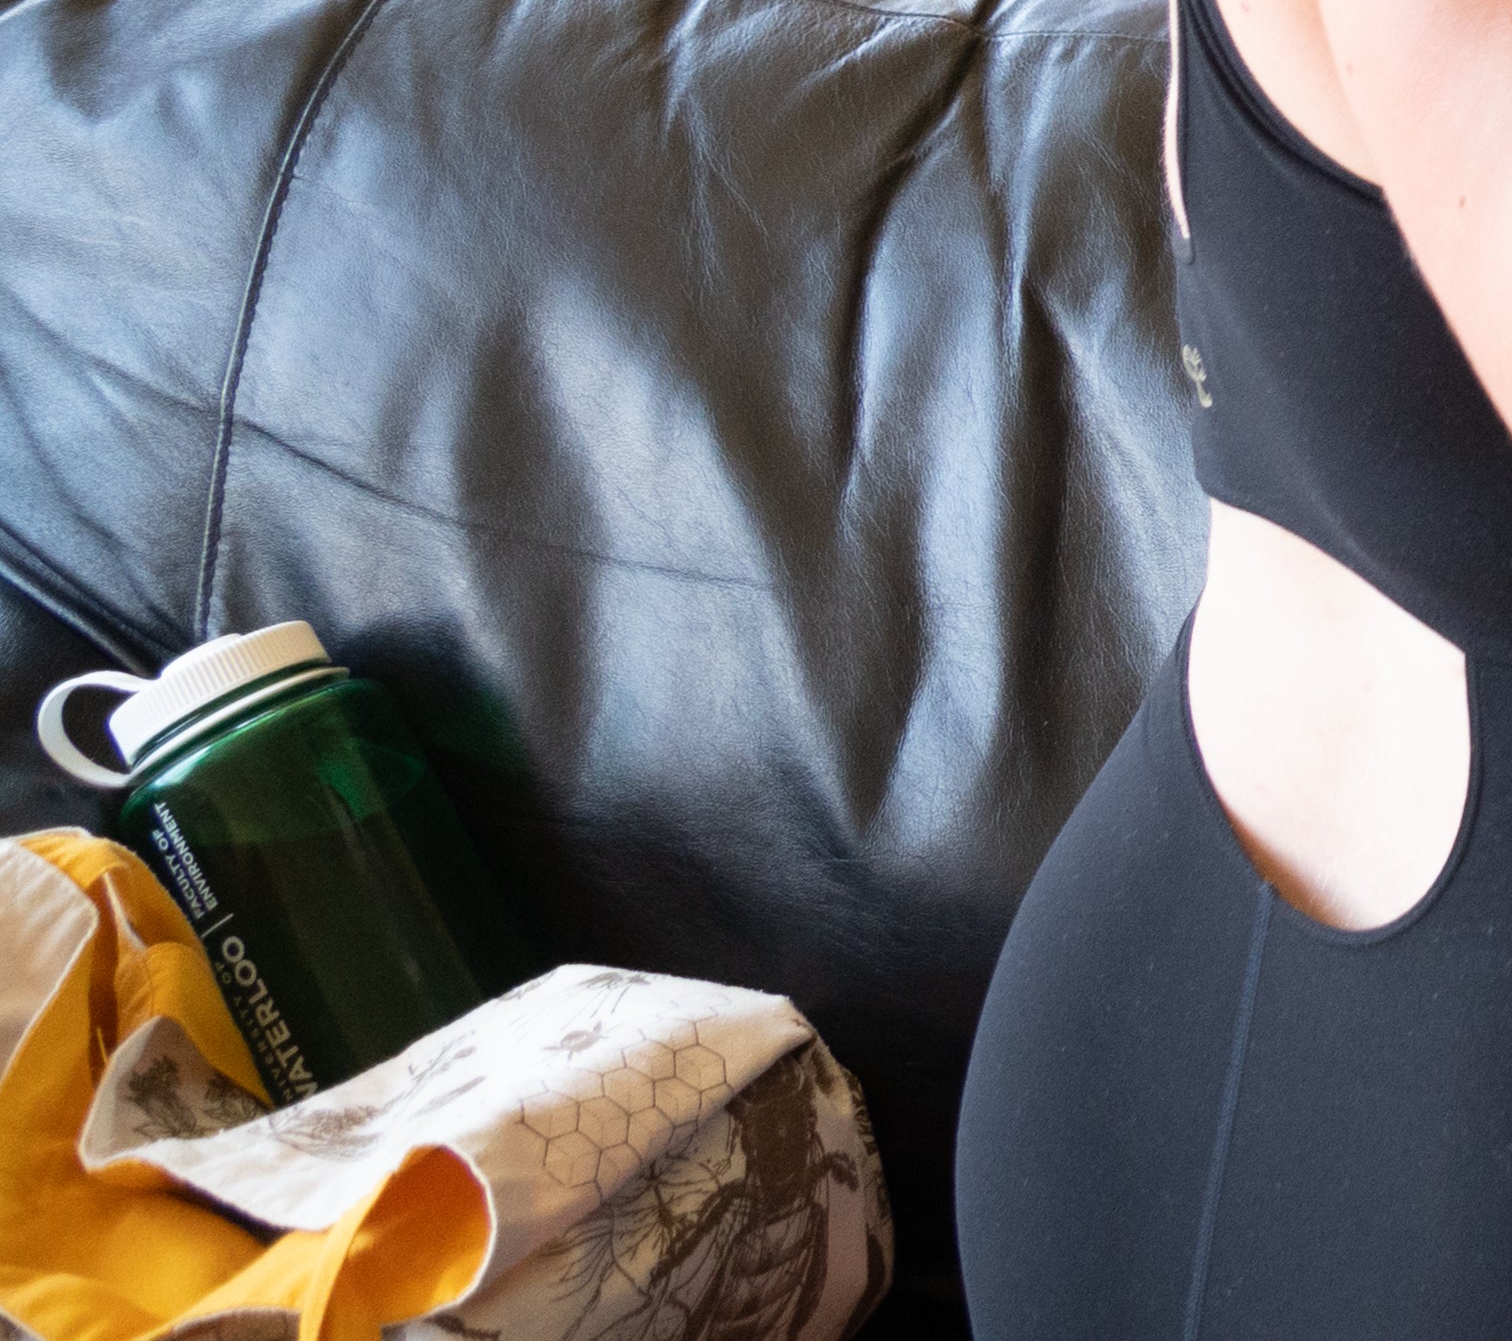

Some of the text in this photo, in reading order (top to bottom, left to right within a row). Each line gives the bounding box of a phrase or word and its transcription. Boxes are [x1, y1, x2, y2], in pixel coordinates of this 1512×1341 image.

[152, 828, 206, 919] FACULTY OF
[153, 801, 218, 911] ENVIRONMENT
